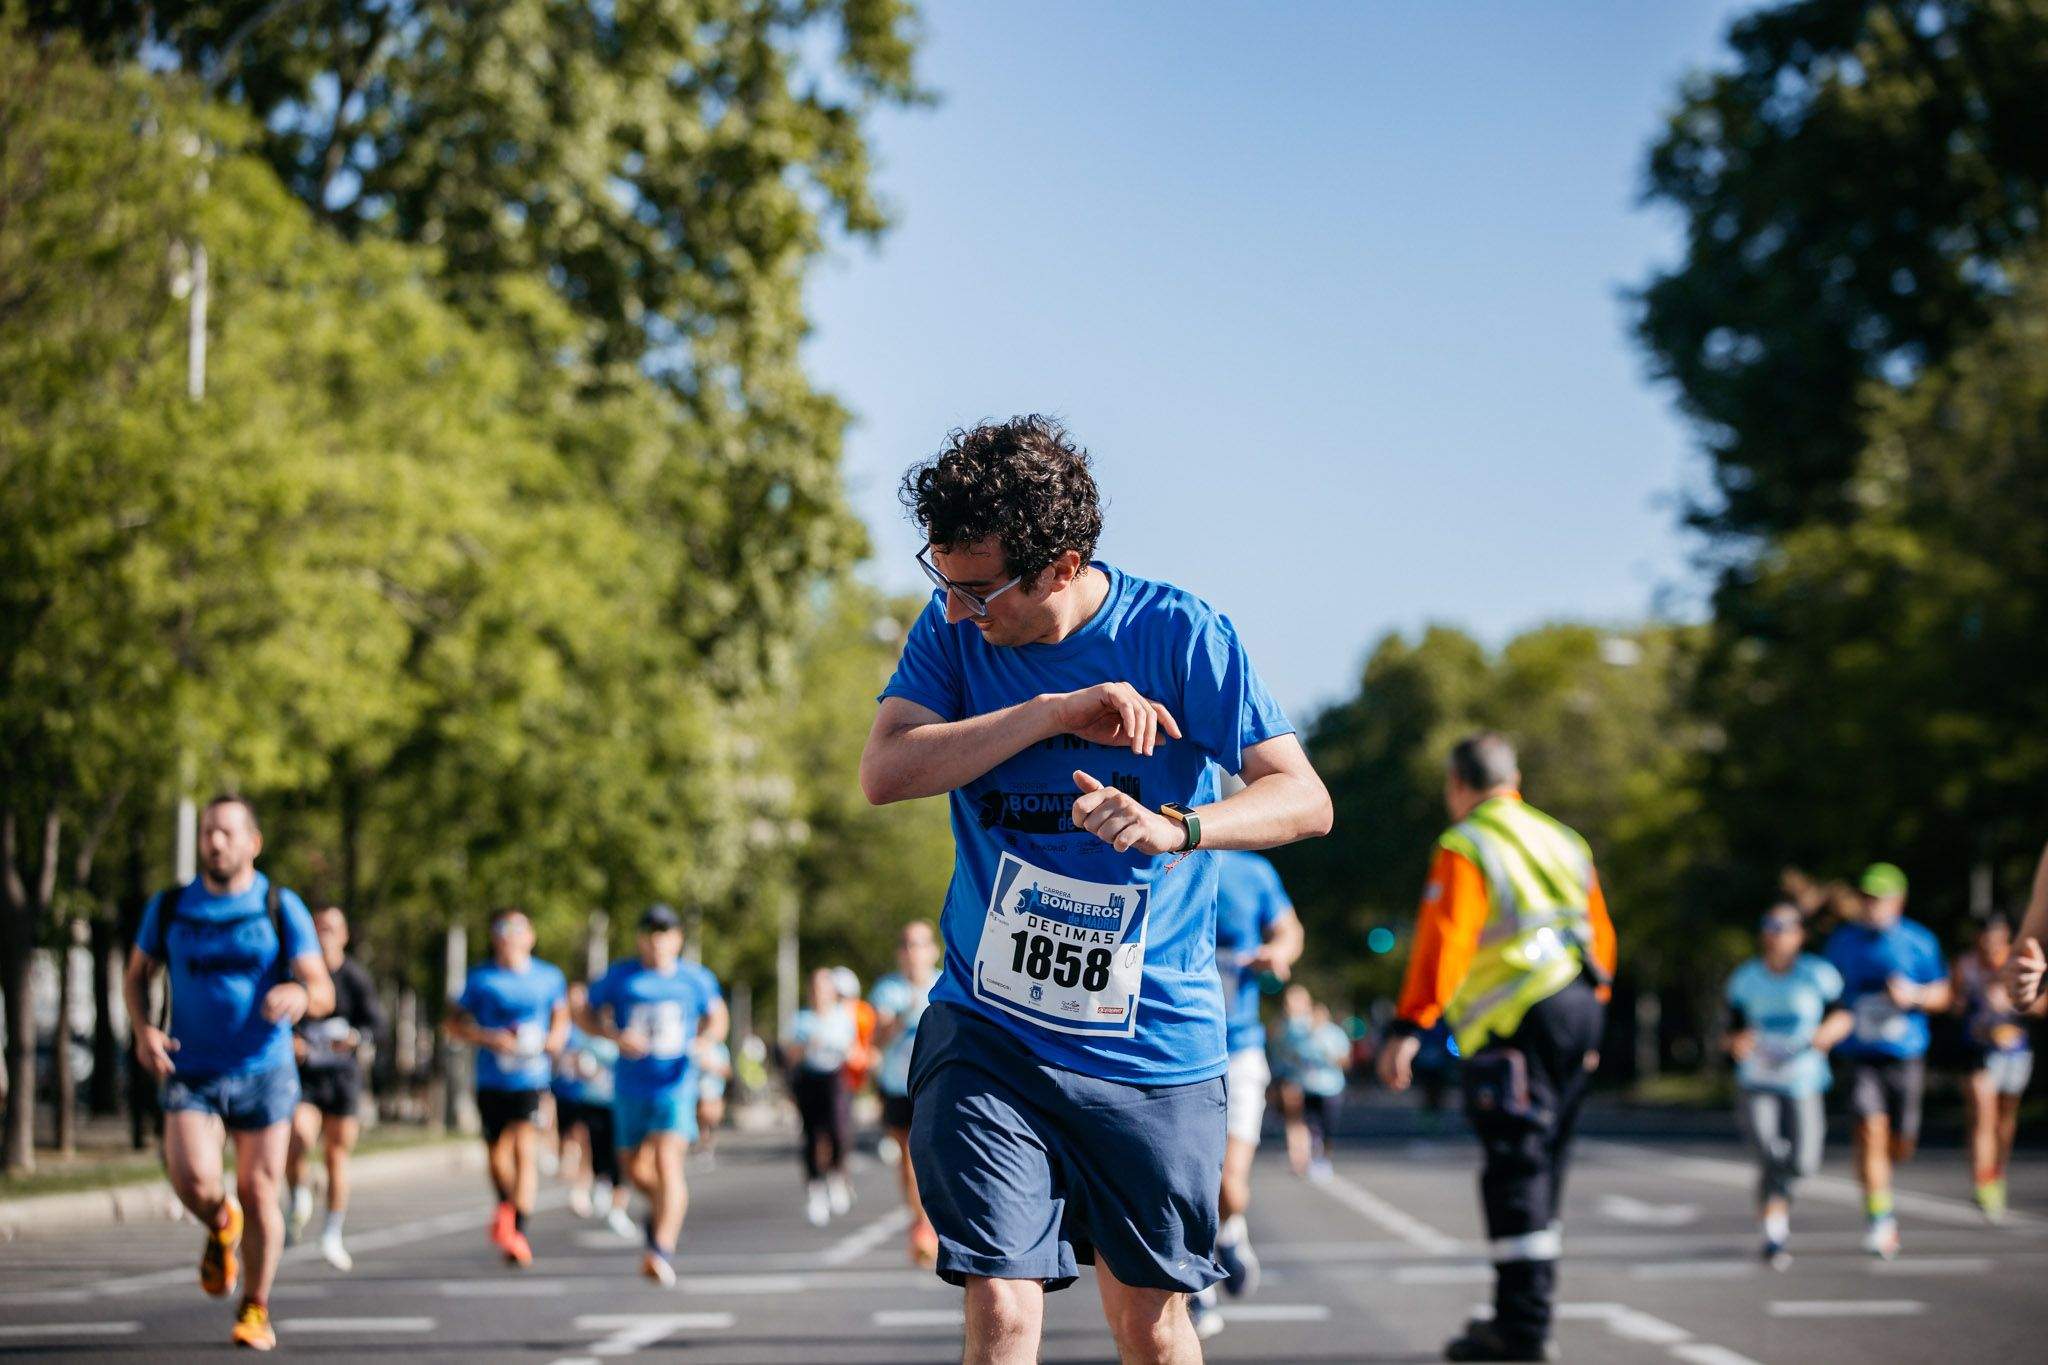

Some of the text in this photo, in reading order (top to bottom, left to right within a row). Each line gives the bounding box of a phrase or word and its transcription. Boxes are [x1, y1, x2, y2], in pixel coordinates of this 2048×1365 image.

[1008, 795, 1075, 812] BOMB
[1043, 886, 1071, 898] CARRERA
[1040, 893, 1120, 919] BOMBEROS
[1027, 915, 1115, 945] DECIMAS
[1068, 912, 1119, 931] de MADRID
[1011, 930, 1112, 992] 1858
